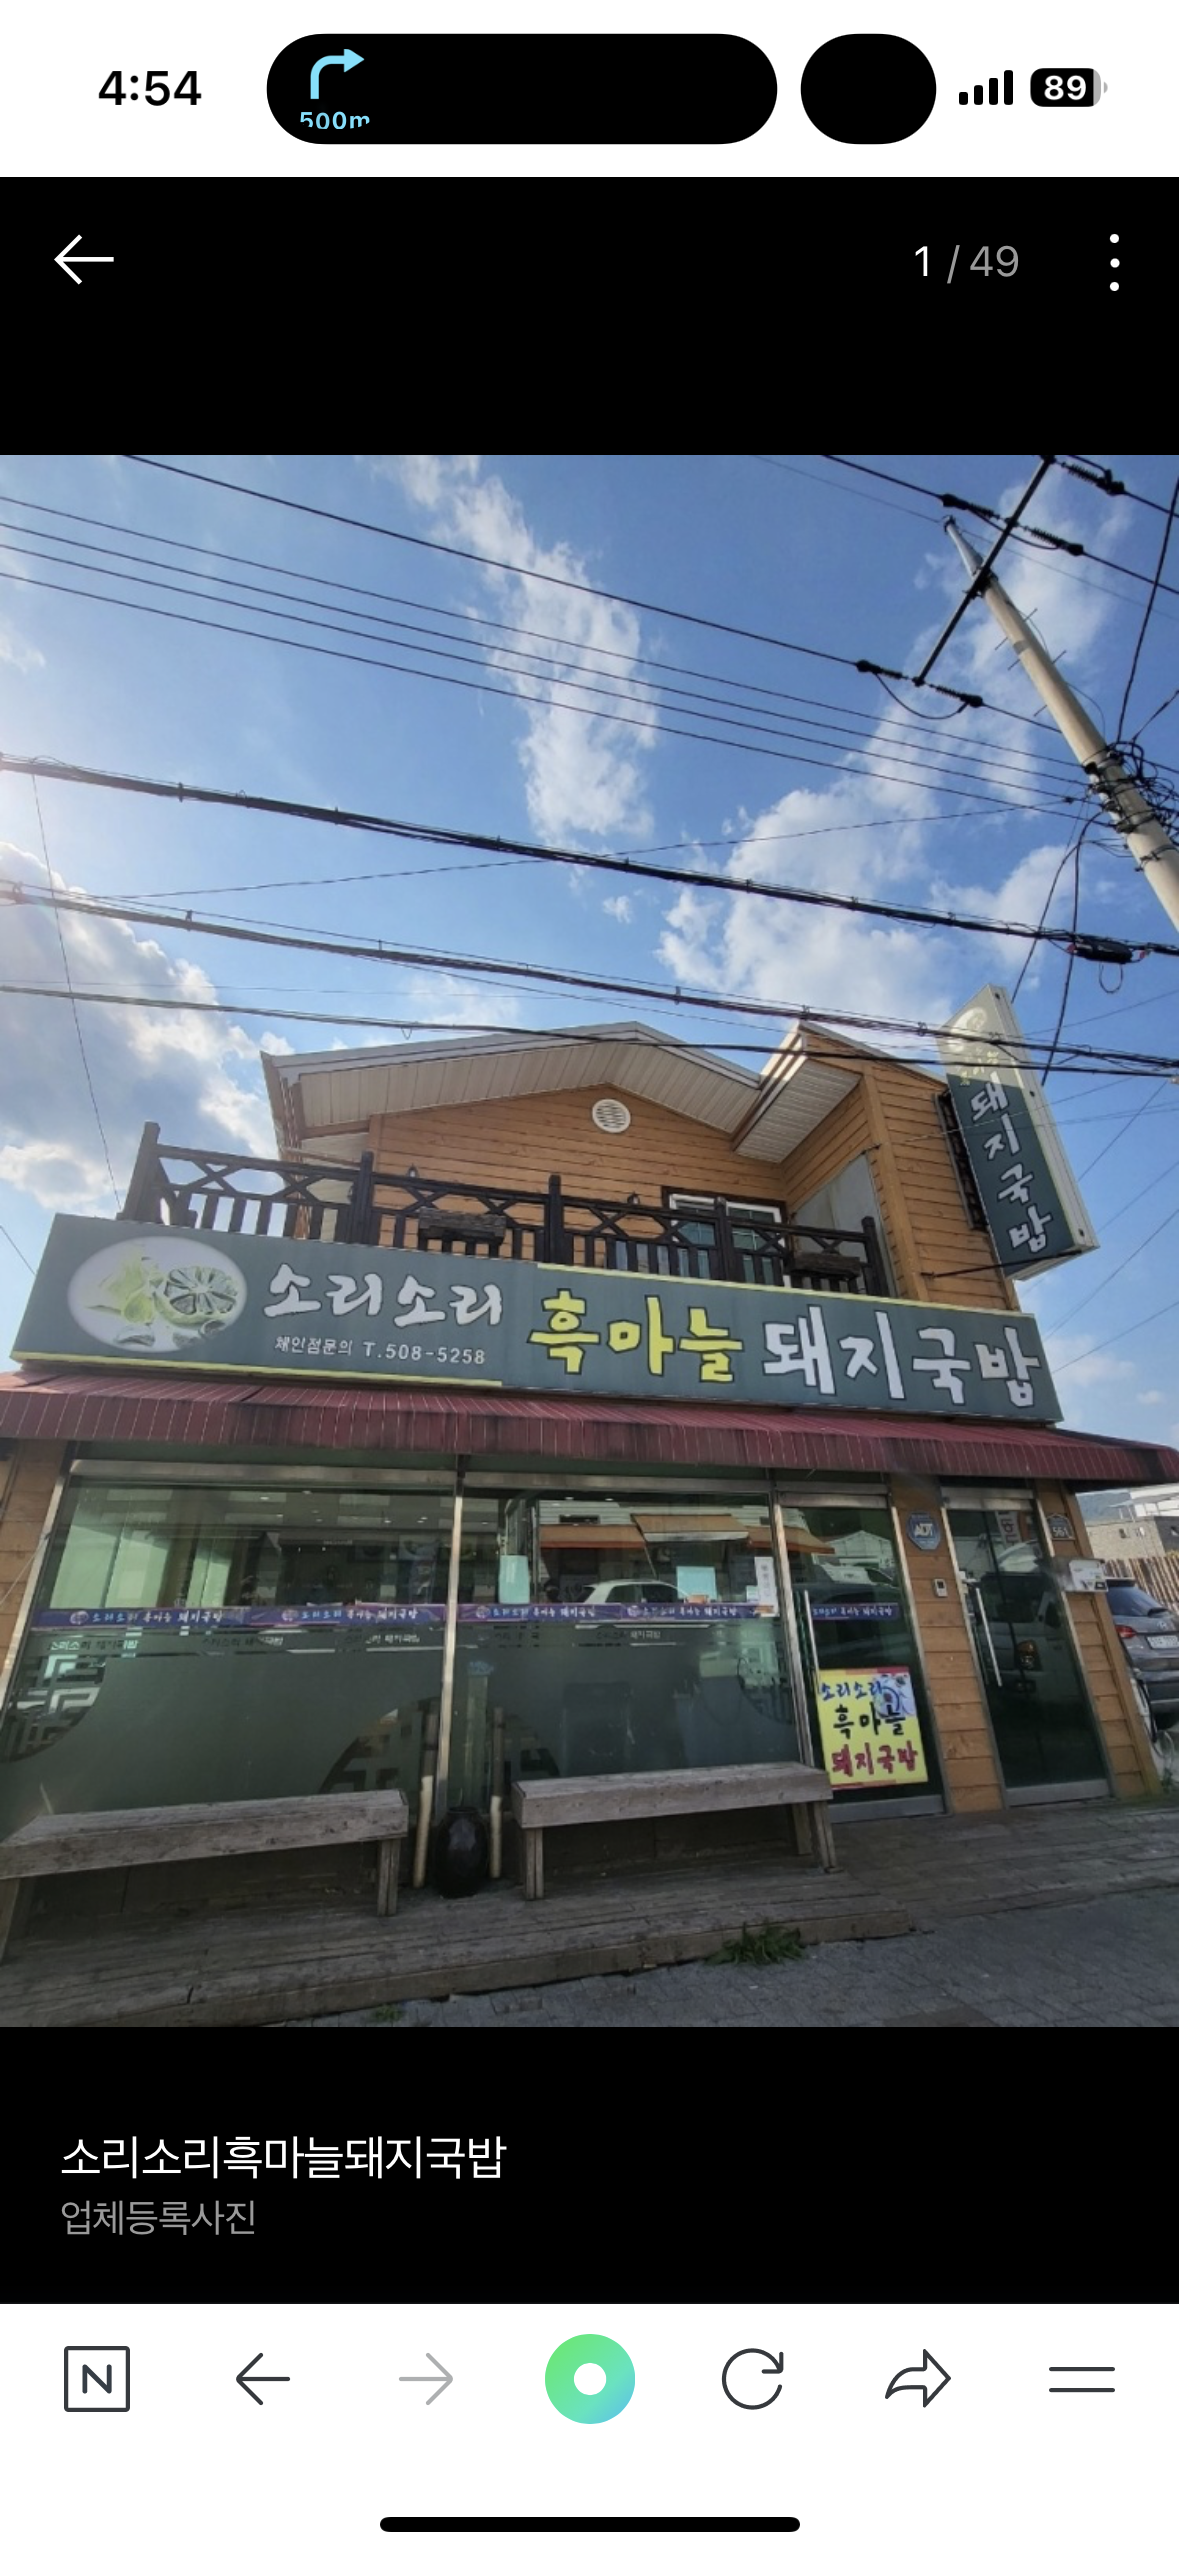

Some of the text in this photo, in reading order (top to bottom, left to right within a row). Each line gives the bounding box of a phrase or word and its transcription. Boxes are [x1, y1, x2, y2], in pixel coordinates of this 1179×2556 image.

[971, 1070, 1052, 1254] 돼지국밥
[262, 1262, 1042, 1408] 소리소리 흑마늘 돼지국밥
[363, 1341, 486, 1365] T.508-5258
[820, 1681, 882, 1702] 소리소리
[833, 1702, 906, 1739] 흑마늘
[831, 1740, 918, 1777] 돼지국밥
